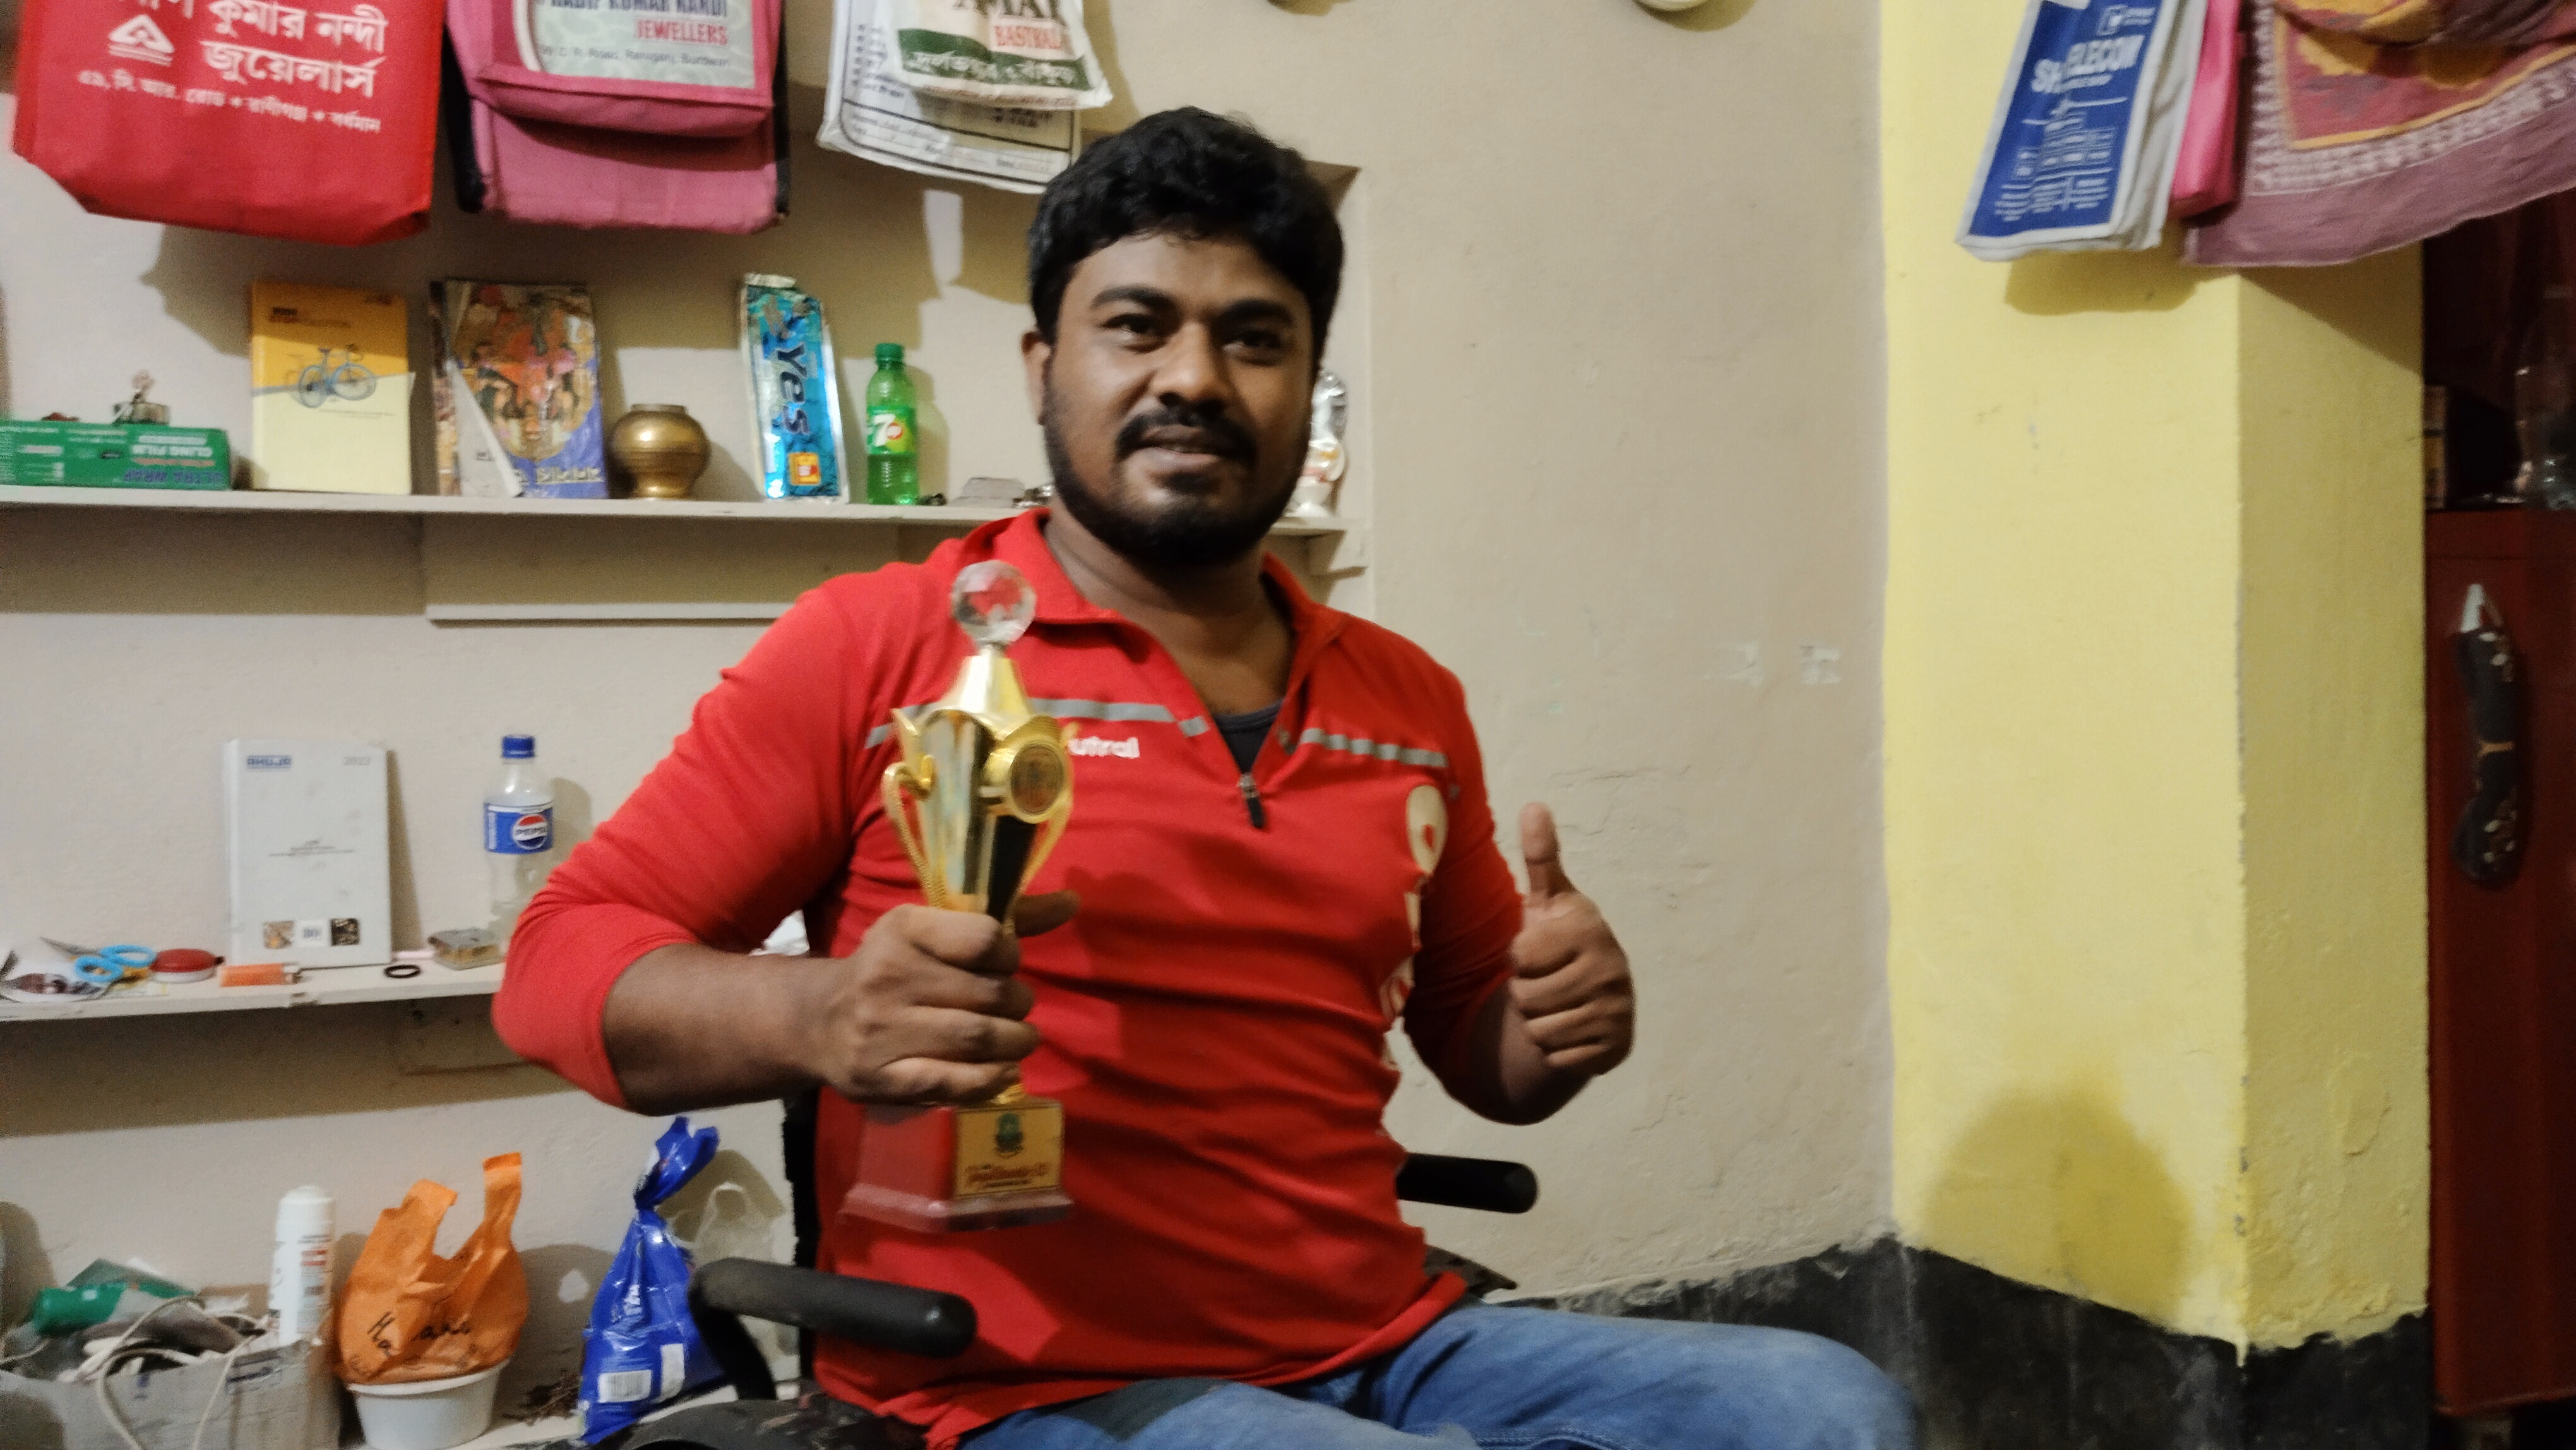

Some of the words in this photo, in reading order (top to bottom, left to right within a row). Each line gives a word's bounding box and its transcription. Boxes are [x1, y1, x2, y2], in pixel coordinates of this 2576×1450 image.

[208, 0, 307, 39] কুমার
[314, 4, 390, 53] নন্দী
[637, 20, 728, 45] JEWELLERS
[200, 40, 386, 98] জুয়েলার্স
[777, 341, 811, 436] Yes
[1066, 736, 1140, 758] utral
